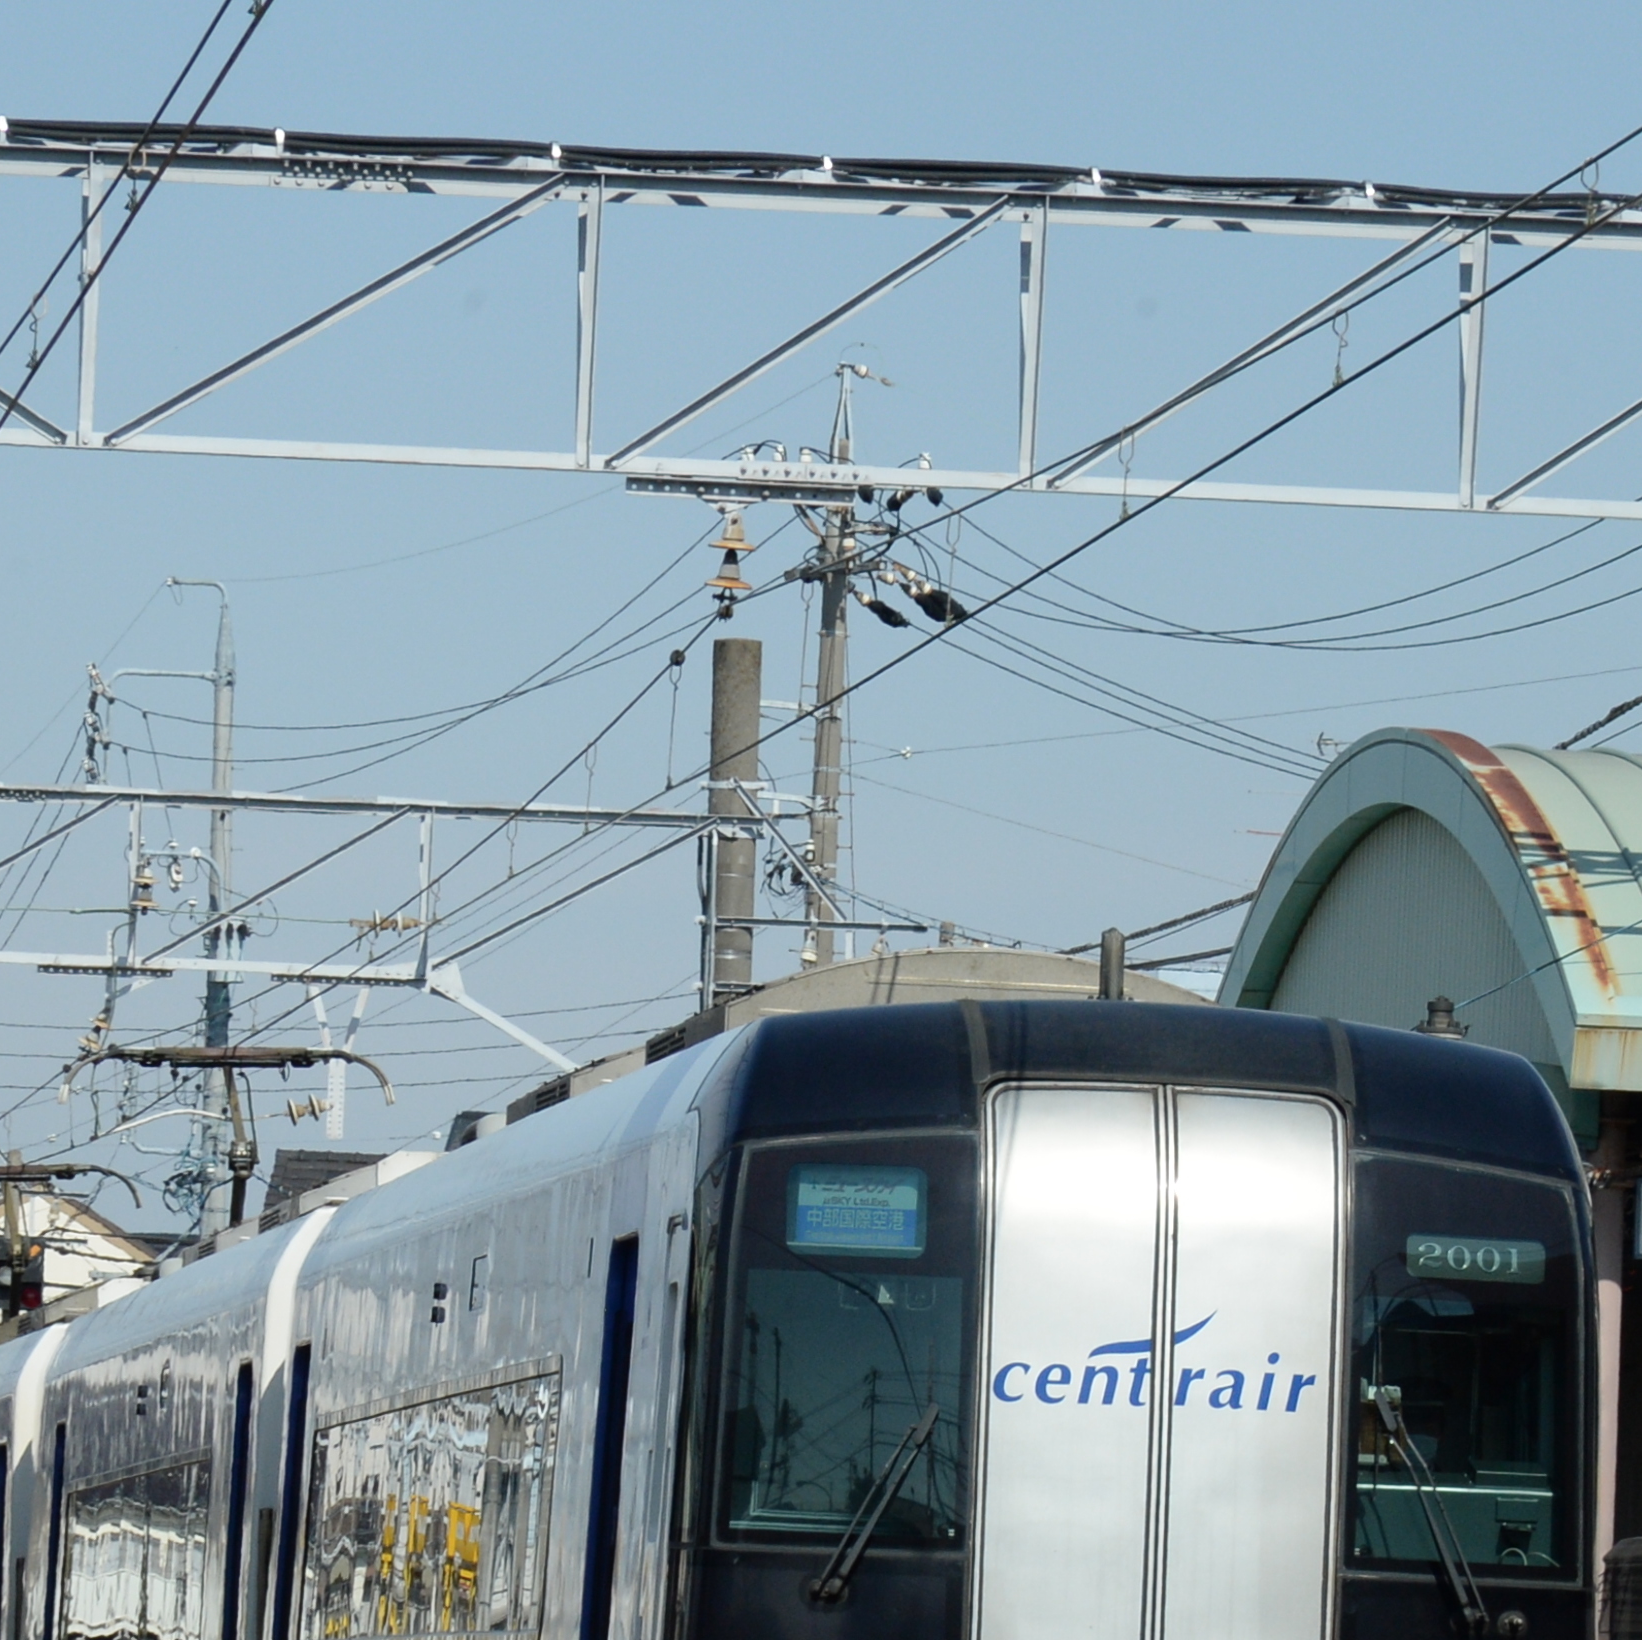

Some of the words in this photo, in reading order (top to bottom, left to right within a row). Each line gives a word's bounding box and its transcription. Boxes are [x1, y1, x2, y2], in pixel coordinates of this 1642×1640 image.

[807, 1207, 905, 1231] 中部国際空港
[1418, 1242, 1522, 1274] 2001
[992, 1351, 1317, 1412] centrair
